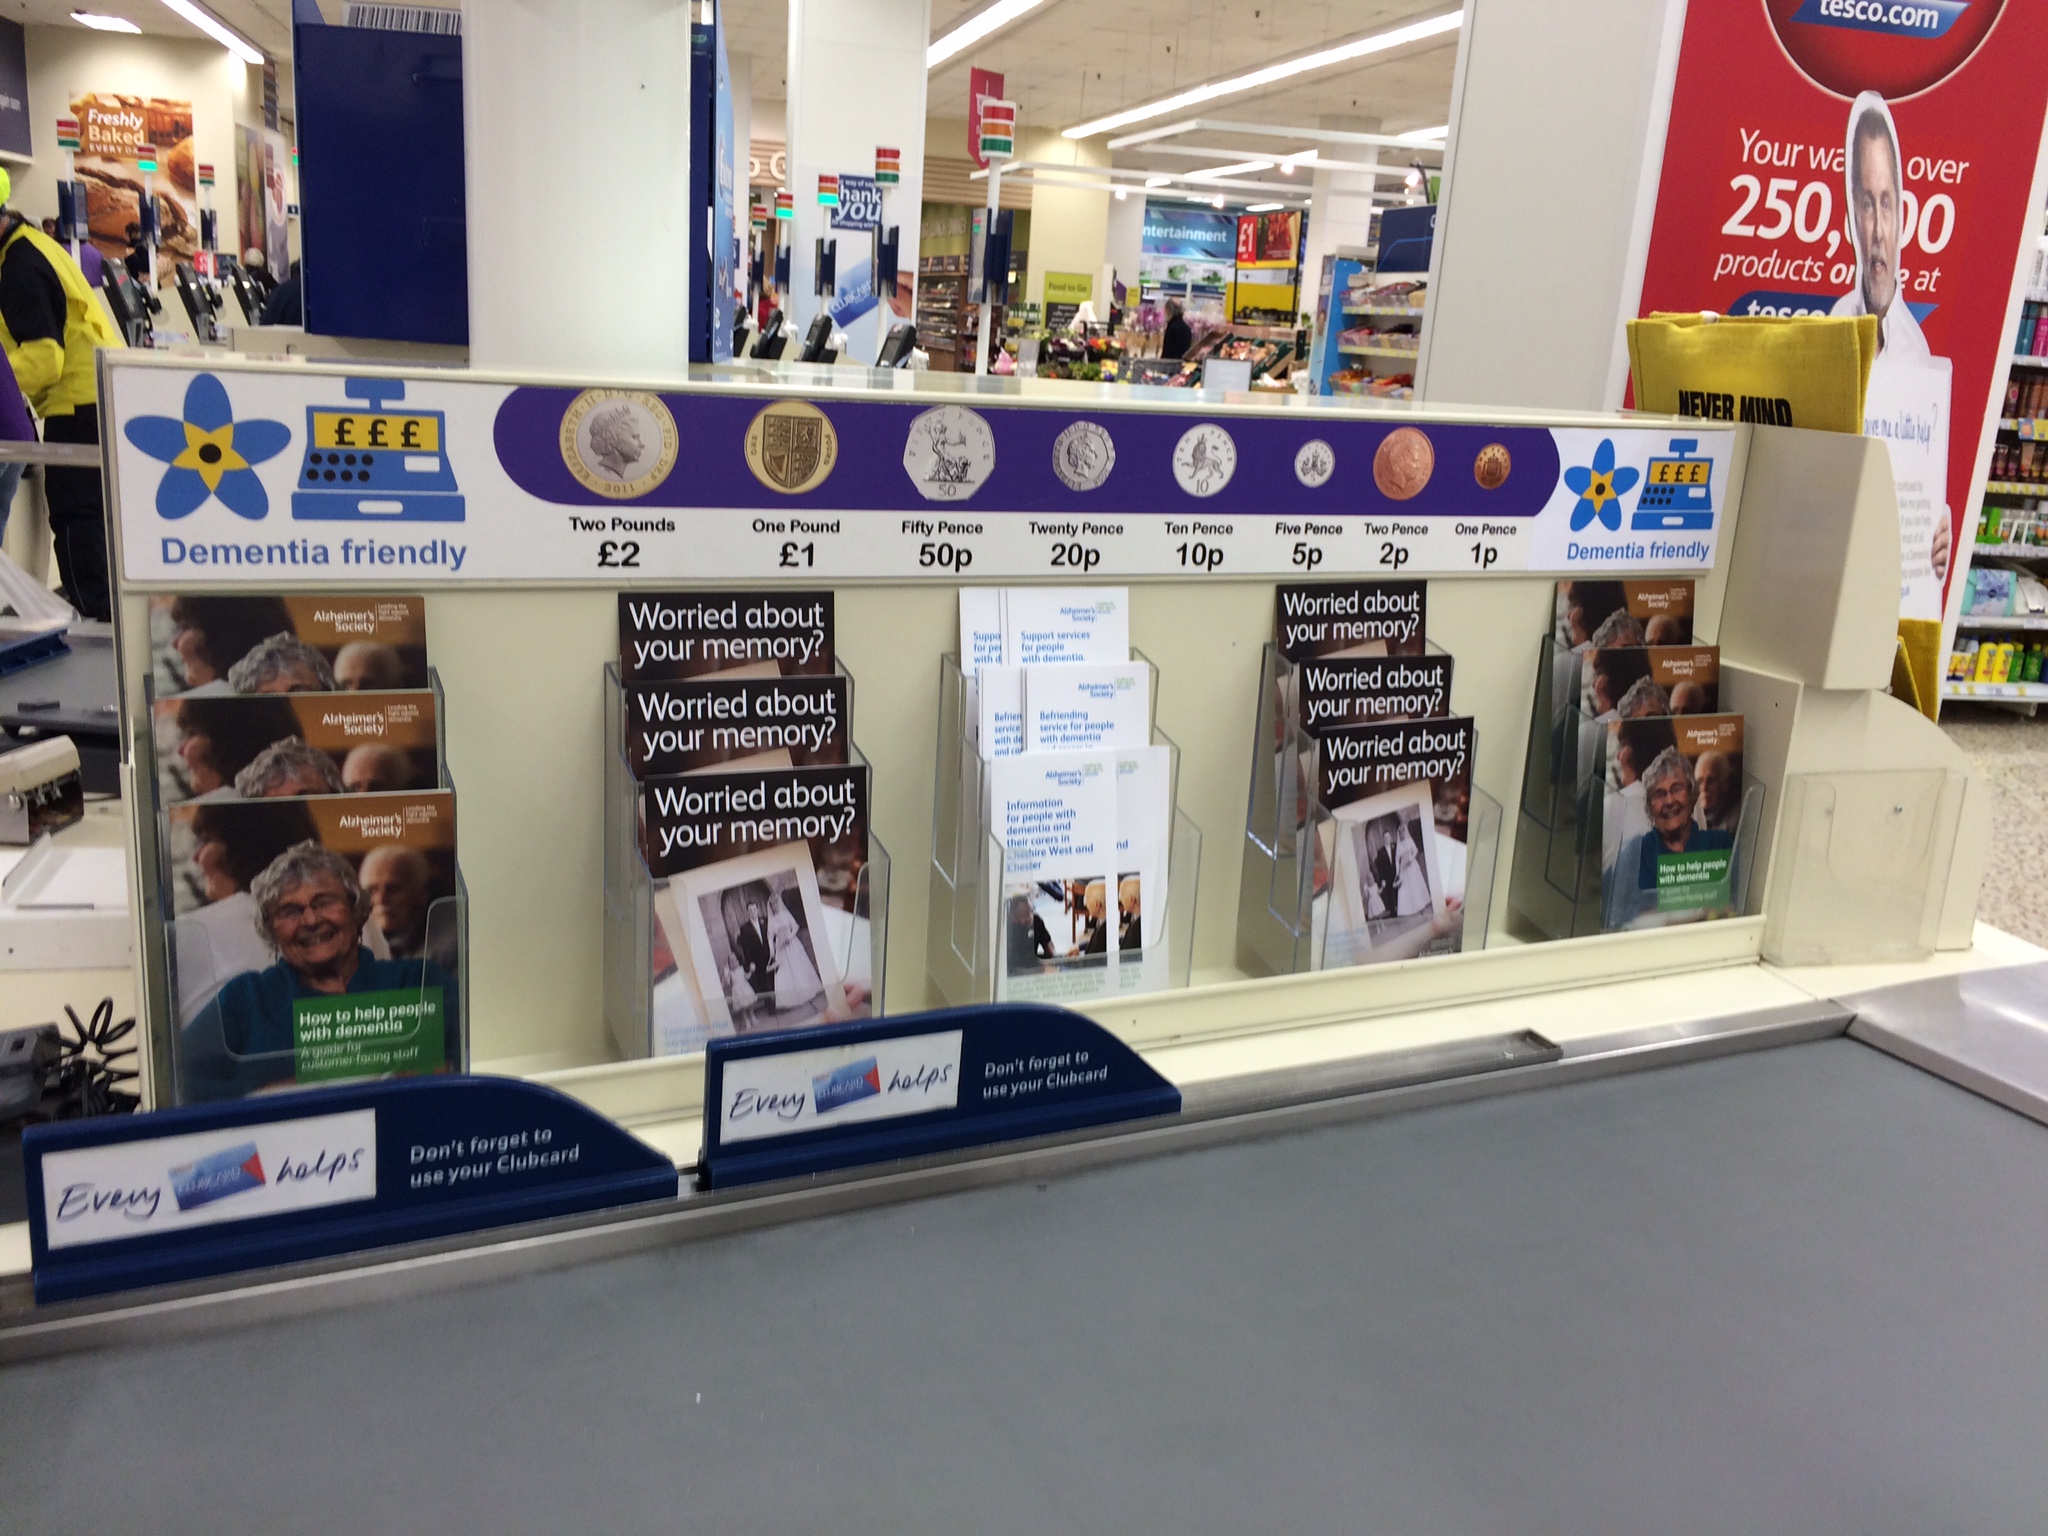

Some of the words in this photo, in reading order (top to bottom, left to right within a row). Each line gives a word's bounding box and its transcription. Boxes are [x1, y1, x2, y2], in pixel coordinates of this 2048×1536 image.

[1820, 0, 1939, 29] tesco.com
[88, 108, 143, 130] Freshly
[89, 125, 144, 145] Baked
[89, 143, 121, 154] EVERY
[1740, 129, 1804, 166] Your
[1808, 145, 1845, 172] wa
[1908, 155, 1969, 184] over
[840, 184, 881, 204] hank
[835, 201, 881, 222] you
[1722, 175, 1955, 257] 250,00
[1142, 224, 1228, 243] ntertainment
[1238, 222, 1255, 254] £1
[1714, 249, 1822, 285] products
[1914, 267, 1940, 293] at
[1678, 389, 1737, 421] NEVER
[1739, 393, 1793, 427] MIND
[938, 483, 957, 498] 50
[1196, 478, 1210, 494] 10
[569, 516, 606, 532] Two
[611, 517, 676, 533] Pounds
[752, 518, 786, 535] One
[790, 519, 841, 536] Pound
[901, 520, 935, 538] Fifty
[937, 520, 984, 536] Pence
[1028, 521, 1078, 538] Twenty
[1081, 522, 1125, 536] Pence
[1164, 522, 1188, 536] Ten
[1191, 522, 1234, 536] Pence
[1275, 523, 1301, 536] Five
[1303, 523, 1343, 536] Pence
[1364, 523, 1387, 536] Two
[1389, 523, 1429, 536] Pence
[1455, 523, 1477, 536] One
[1479, 523, 1517, 536] Pence
[161, 537, 330, 566] Dementia
[340, 538, 468, 571] friendly
[597, 541, 641, 568] £2
[778, 542, 816, 567] £1
[919, 543, 973, 572] 50p
[1051, 543, 1101, 572] 20p
[1176, 543, 1224, 572] 10p
[1291, 543, 1323, 571] 5p
[1379, 543, 1410, 570] 2p
[1470, 543, 1499, 569] 1p
[1566, 542, 1646, 561] Dementia
[1649, 541, 1711, 563] friendly
[1283, 590, 1359, 616] Worried
[1363, 589, 1420, 614] about
[1637, 593, 1669, 601] Alzheimer's
[1647, 600, 1669, 609] Society
[314, 610, 375, 623] Alzheimer's
[628, 600, 737, 631] Worried
[745, 600, 825, 629] about
[1060, 606, 1096, 615] Alzheimer's
[1072, 614, 1096, 623] Society
[335, 621, 375, 635] Society
[1021, 631, 1055, 642] Support
[1057, 631, 1091, 640] services
[1285, 623, 1328, 649] your
[1332, 613, 1420, 644] memory?
[633, 638, 695, 670] your
[702, 629, 825, 665] memory?
[1021, 643, 1035, 652] for
[1036, 642, 1065, 653] people
[1021, 654, 1041, 663] with
[1661, 659, 1694, 668] Alzheimer's
[1305, 664, 1382, 692] Worried
[1386, 664, 1444, 689] about
[1672, 666, 1694, 676] Society
[1078, 683, 1114, 691] Alzheimer's
[1090, 690, 1114, 699] Society
[637, 689, 748, 723] Worried
[755, 688, 837, 718] about
[1306, 698, 1351, 725] your
[1355, 688, 1444, 718] memory?
[322, 712, 384, 725] Alzheimer's
[1039, 710, 1089, 721] Befriending
[343, 723, 384, 737] Society
[1039, 723, 1067, 732] service
[1069, 721, 1083, 731] for
[1084, 720, 1115, 732] people
[1686, 729, 1718, 739] Alzheimer's
[642, 729, 705, 763] your
[712, 716, 837, 753] memory?
[1039, 734, 1059, 743] with
[1060, 732, 1101, 743] dementia
[1327, 731, 1403, 762] Worried
[1408, 728, 1467, 754] about
[1696, 736, 1718, 746] Society
[1045, 769, 1083, 780] Alzheimer's
[1057, 777, 1083, 787] Society
[1326, 765, 1371, 795] your
[1375, 751, 1465, 782] memory?
[654, 780, 766, 818] Worried
[774, 778, 856, 809] about
[1006, 798, 1063, 812] Information
[339, 814, 403, 828] Alzheimer's
[1006, 813, 1020, 824] for
[1022, 811, 1053, 825] people
[1055, 808, 1077, 820] with
[361, 824, 403, 839] Society
[659, 821, 723, 858] your
[729, 806, 856, 845] memory?
[1006, 823, 1051, 836] dementia
[1053, 821, 1072, 833] and
[1006, 837, 1029, 849] their
[1030, 836, 1059, 848] carers
[1060, 834, 1070, 844] in
[1048, 845, 1073, 857] West
[1075, 843, 1094, 855] and
[1659, 864, 1676, 875] How
[1677, 862, 1686, 873] to
[1686, 861, 1702, 872] help
[1702, 858, 1727, 872] people
[1659, 874, 1676, 885] with
[1676, 871, 1710, 883] dementia
[299, 1012, 332, 1028] How
[336, 1009, 351, 1023] to
[354, 1005, 385, 1023] help
[388, 1000, 437, 1019] people
[299, 1025, 332, 1043] with
[335, 1018, 404, 1039] dementia
[984, 1057, 1025, 1079] Don't
[1028, 1052, 1071, 1072] forget
[1074, 1050, 1089, 1065] to
[983, 1084, 1008, 1100] use
[1009, 1077, 1044, 1099] your
[1046, 1064, 1108, 1089] Clubcard
[729, 1088, 806, 1124] Every
[887, 1063, 953, 1096] helps
[409, 1139, 465, 1165] Don't
[470, 1131, 529, 1155] forget
[533, 1128, 553, 1145] to
[410, 1169, 444, 1190] use
[447, 1161, 493, 1187] your
[496, 1143, 580, 1174] Clubcard
[56, 1183, 161, 1223] Every
[275, 1147, 365, 1186] helps
